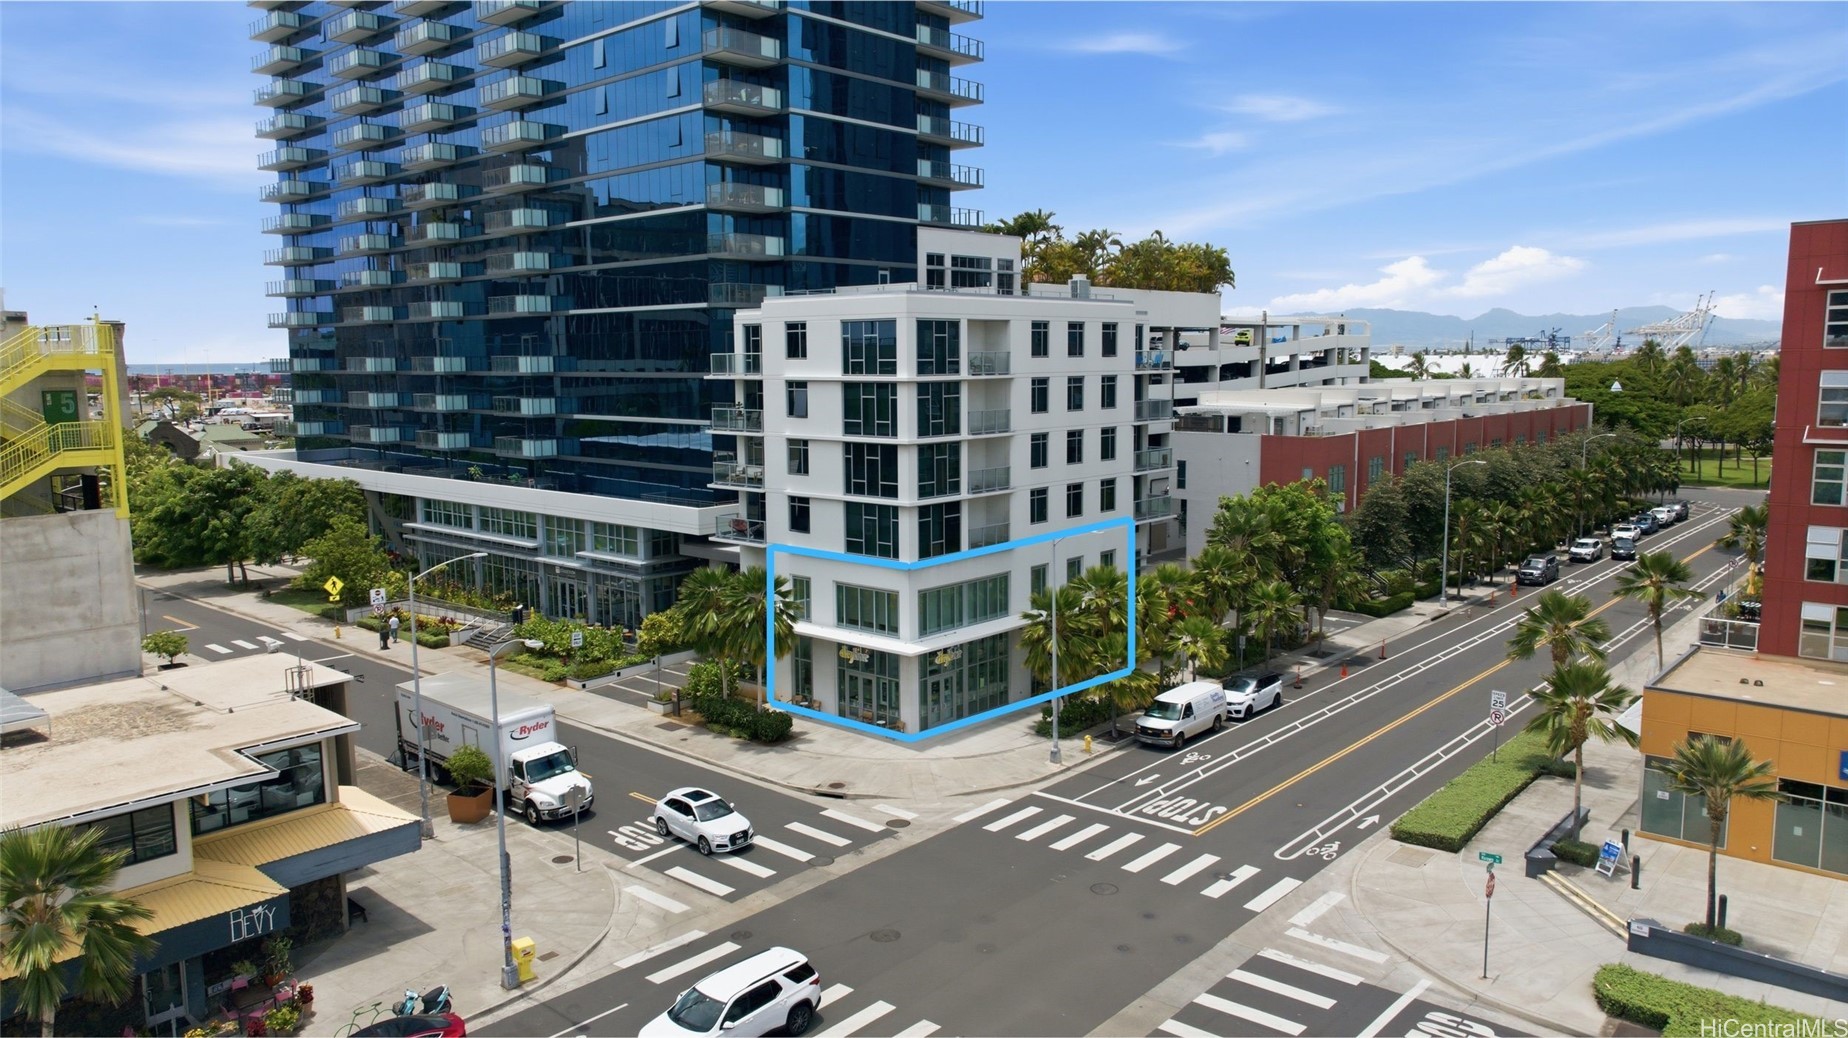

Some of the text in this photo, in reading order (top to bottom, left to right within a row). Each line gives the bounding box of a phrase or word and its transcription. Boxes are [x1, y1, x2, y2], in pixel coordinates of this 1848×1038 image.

[60, 392, 76, 414] 5
[1492, 699, 1505, 709] 25
[420, 711, 445, 733] yder
[519, 720, 549, 736] Ryder
[1142, 795, 1228, 826] STOP
